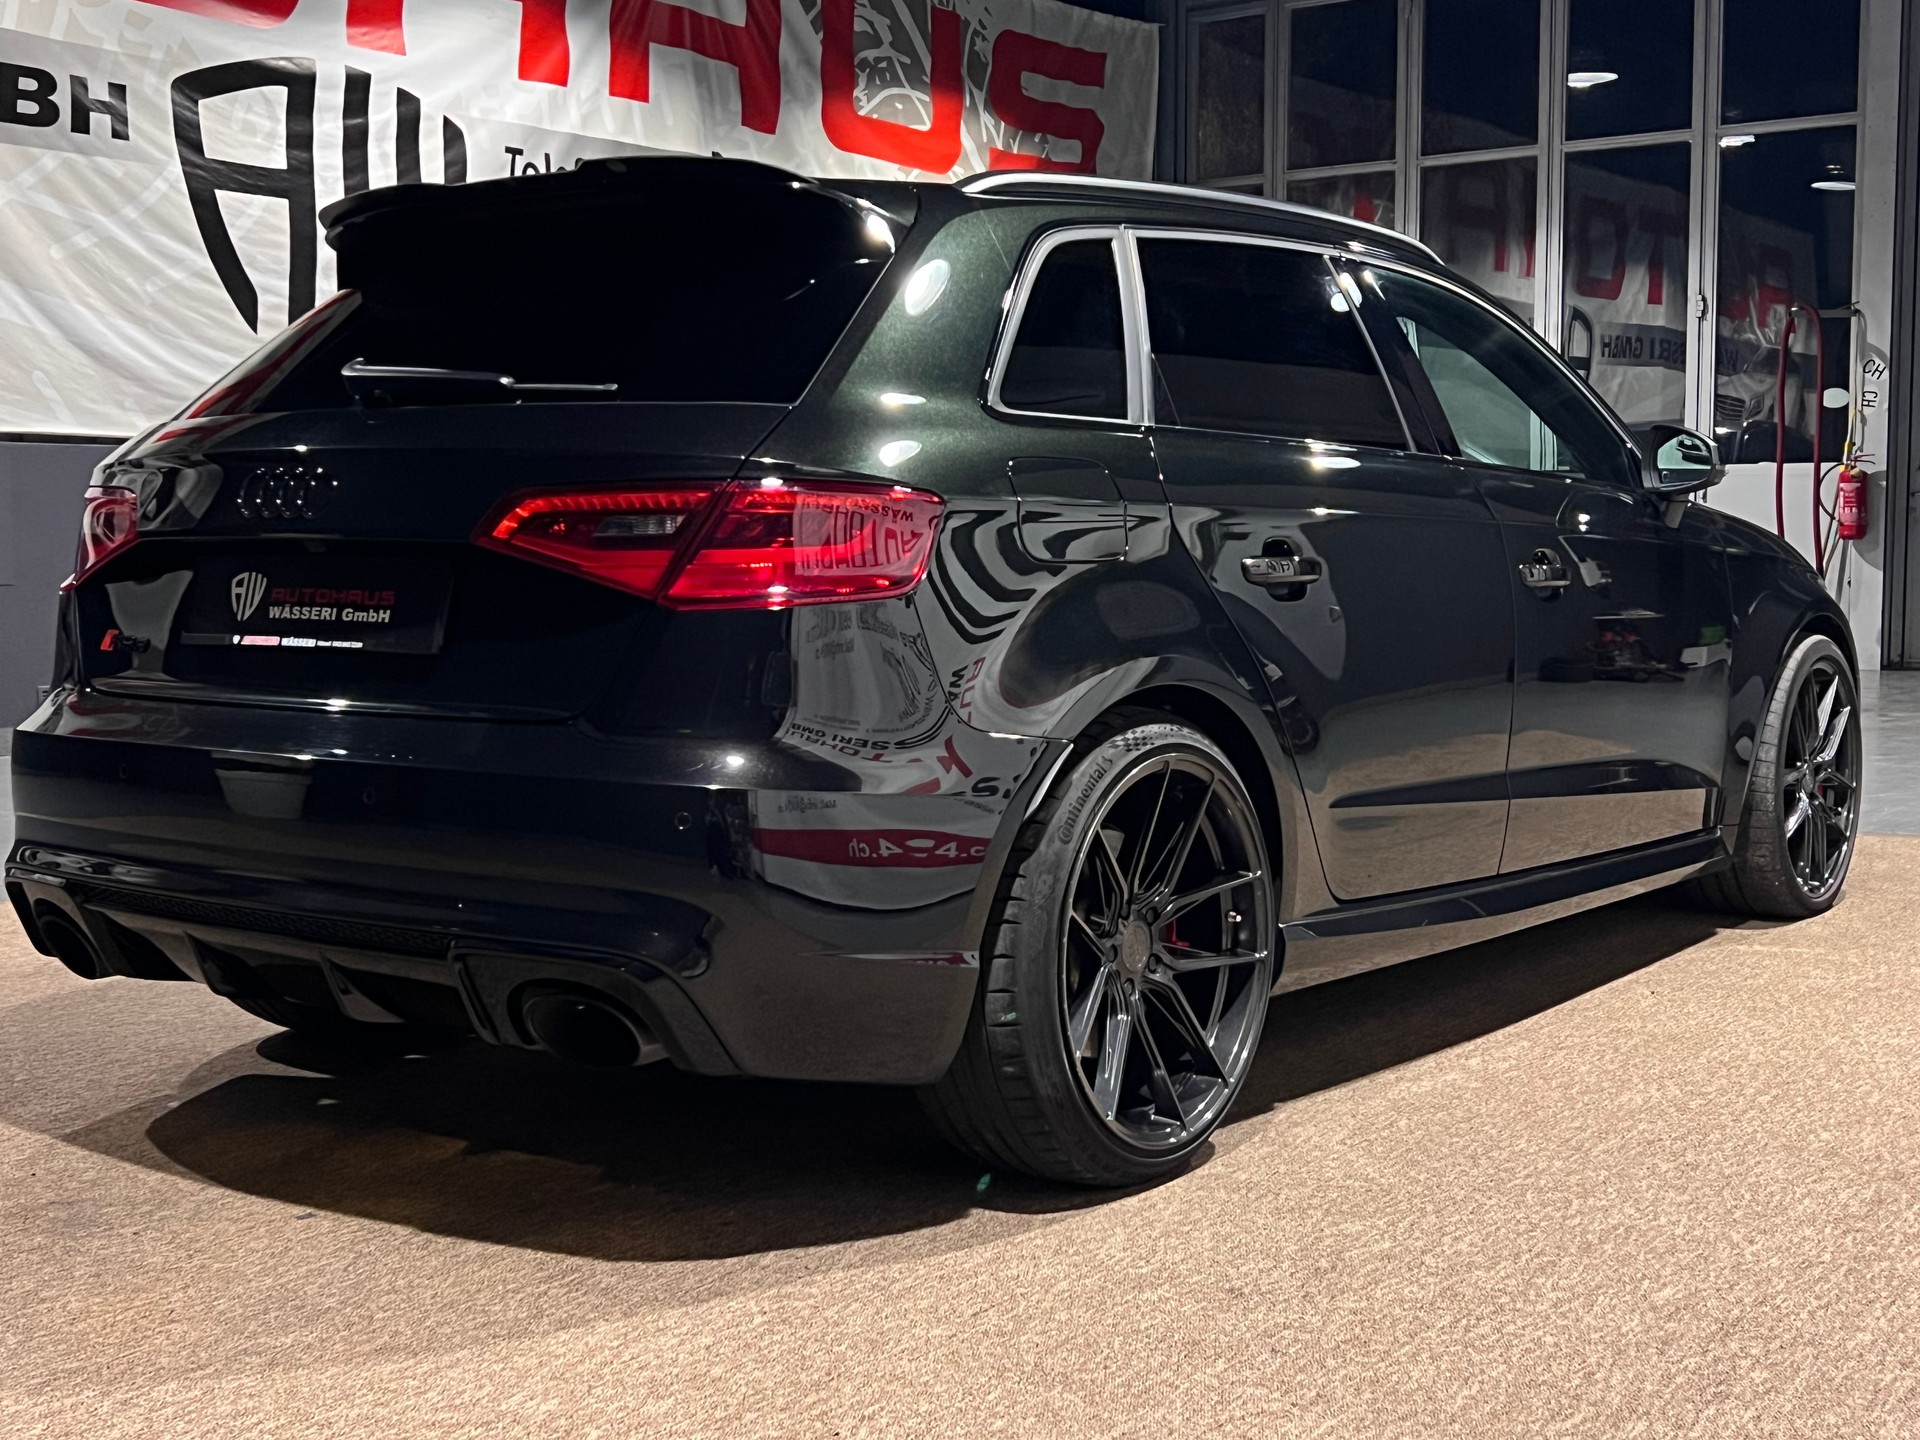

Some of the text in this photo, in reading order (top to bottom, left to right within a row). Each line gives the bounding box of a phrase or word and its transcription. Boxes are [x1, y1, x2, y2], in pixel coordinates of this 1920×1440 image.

[1862, 359, 1887, 380] CH
[1861, 390, 1878, 408] CH
[271, 588, 396, 606] AUTOHAUS
[268, 604, 391, 623] WÄSSERI GmbH
[1057, 761, 1108, 845] Continental
